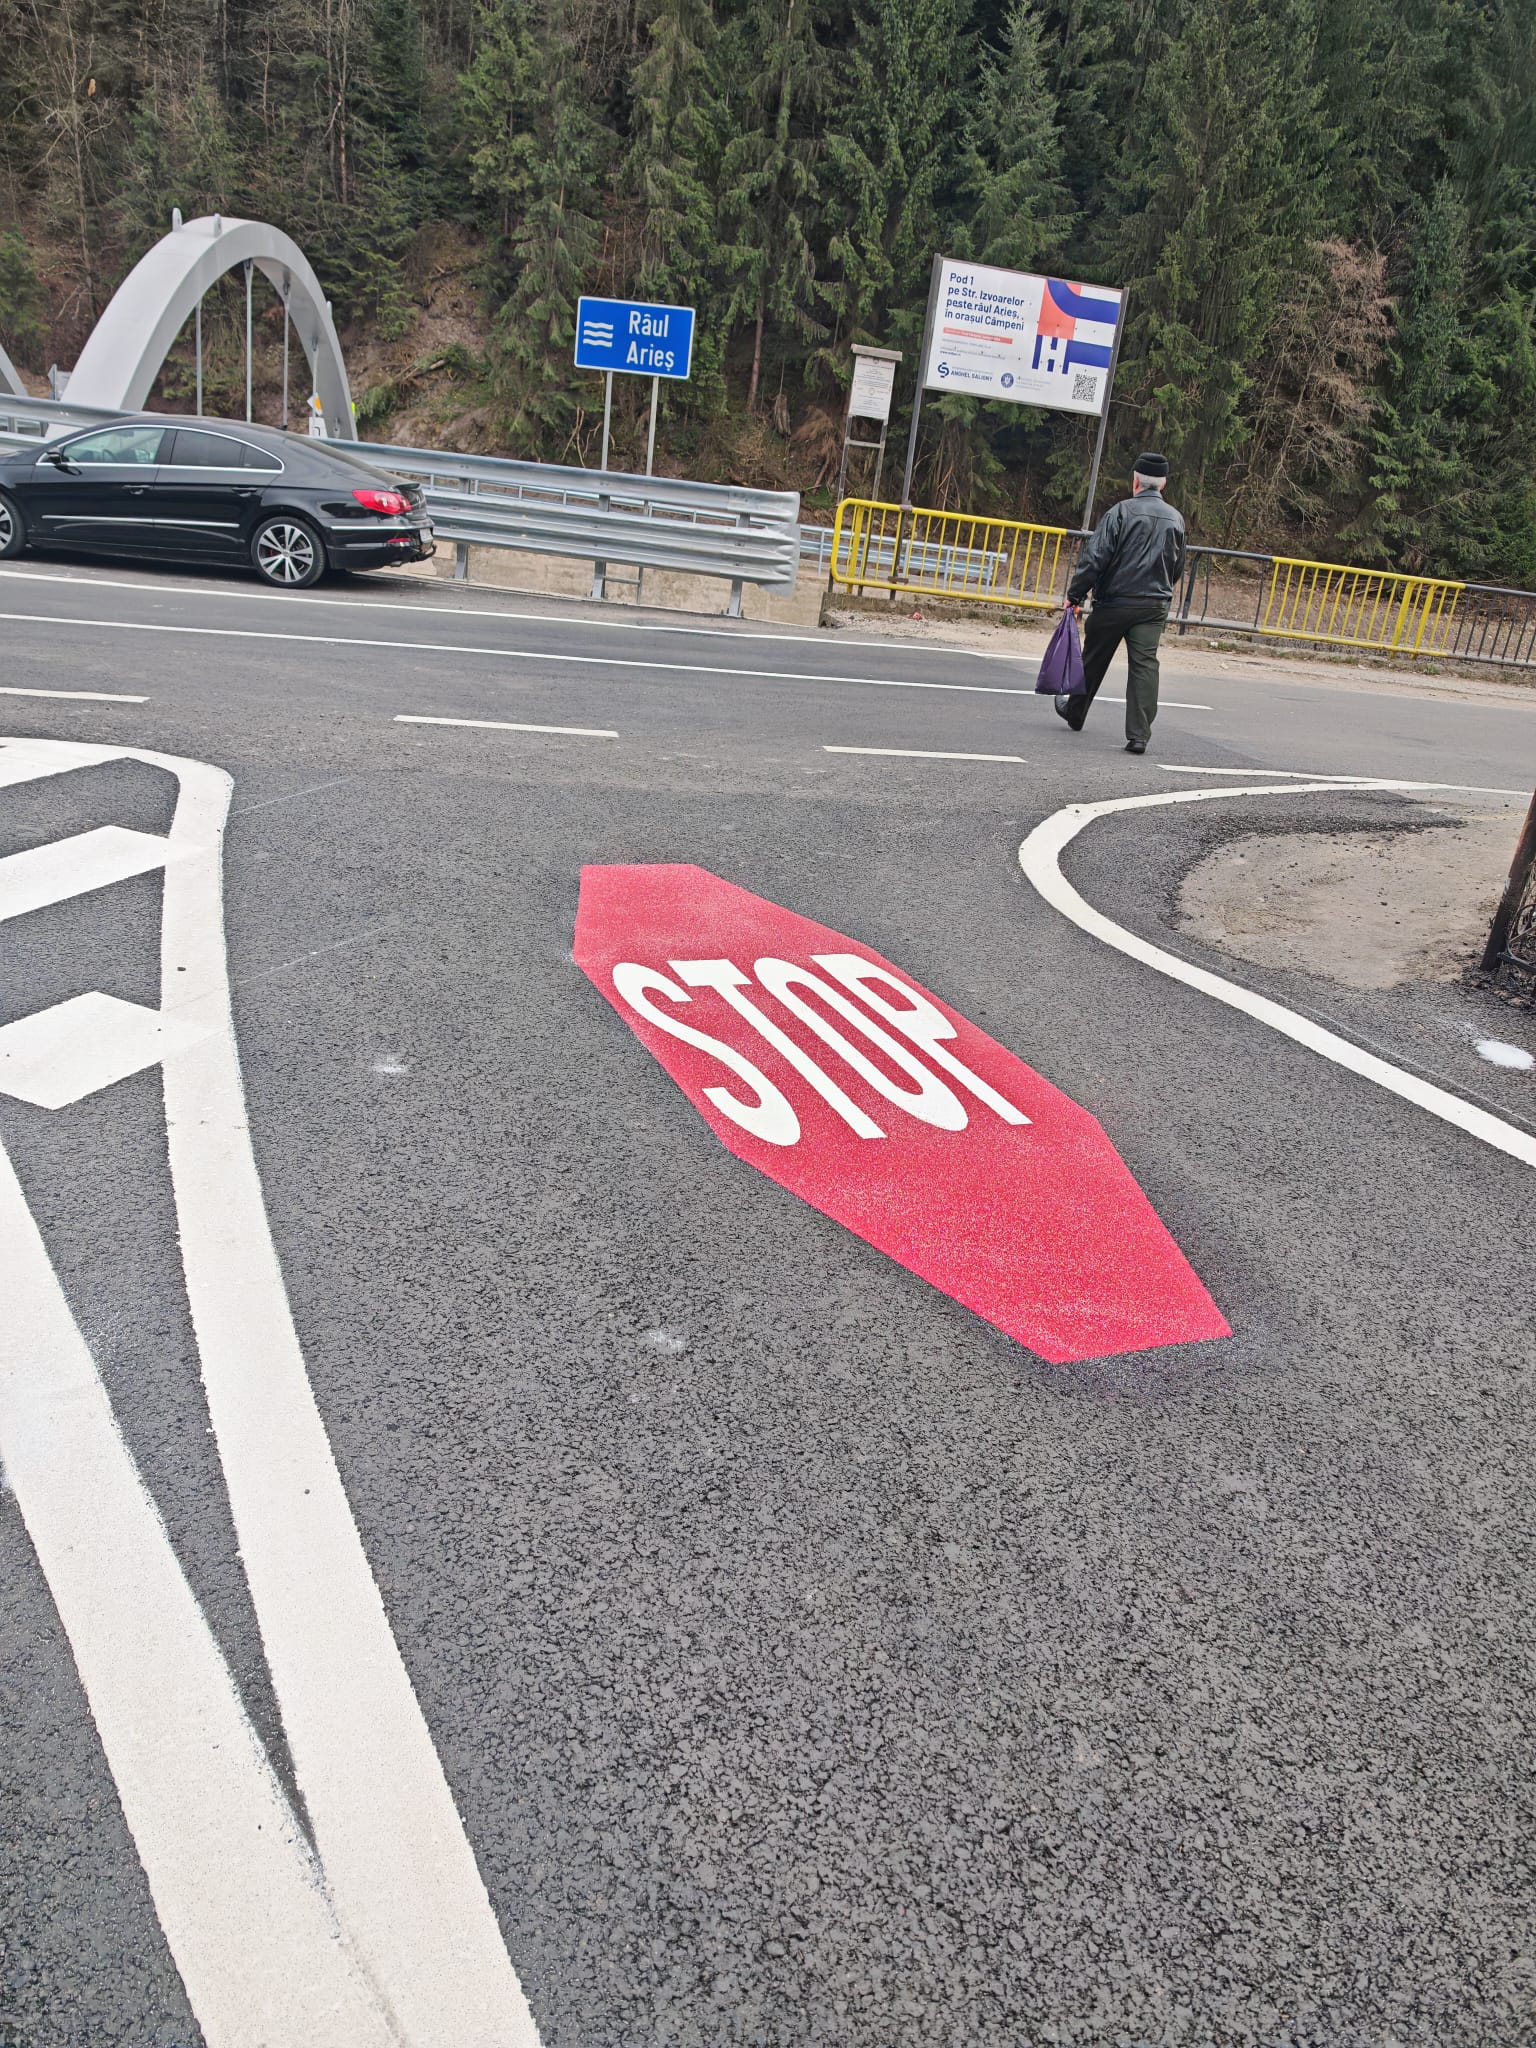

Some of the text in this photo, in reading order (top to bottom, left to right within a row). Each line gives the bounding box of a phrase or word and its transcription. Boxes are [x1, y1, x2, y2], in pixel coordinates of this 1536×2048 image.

[950, 272, 974, 285] Pod 1
[946, 298, 973, 310] peste
[974, 302, 992, 314] râul
[948, 287, 1025, 307] pe Str. Izvoarelor
[629, 310, 669, 338] Râul
[955, 312, 984, 325] orașul
[984, 315, 1025, 332] Câmpeni
[626, 340, 675, 372] Arieș
[612, 953, 1033, 1146] STOP
